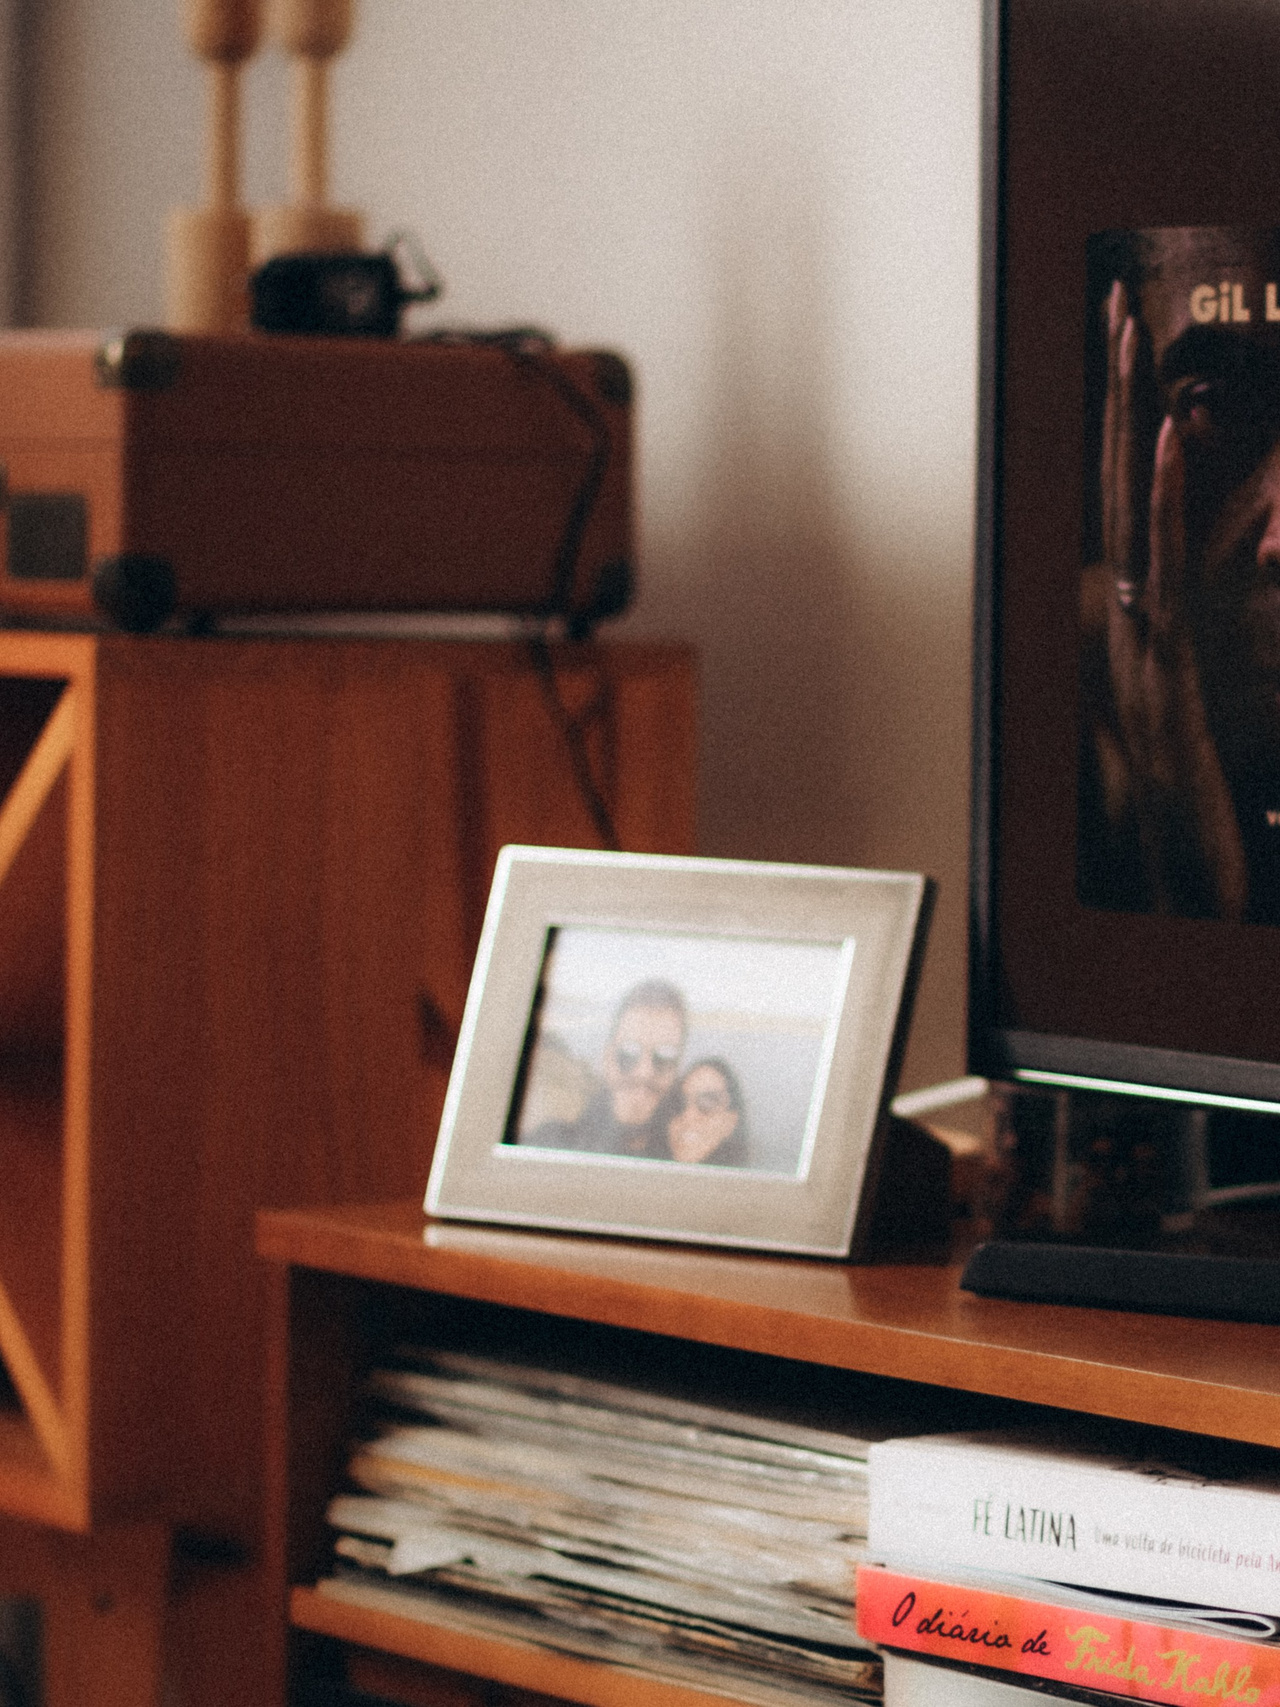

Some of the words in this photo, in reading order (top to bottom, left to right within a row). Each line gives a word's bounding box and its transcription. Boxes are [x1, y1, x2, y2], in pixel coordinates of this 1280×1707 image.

[973, 1494, 993, 1535] FÉ
[1004, 1503, 1076, 1551] LATINA
[1160, 1539, 1174, 1555] de
[1178, 1539, 1231, 1564] bicicleta
[1235, 1550, 1262, 1570] pela
[892, 1592, 916, 1627] O
[916, 1608, 1013, 1648] diário
[1021, 1629, 1051, 1656] de
[1065, 1626, 1156, 1686] Frida
[1157, 1650, 1260, 1705] Kahlo
